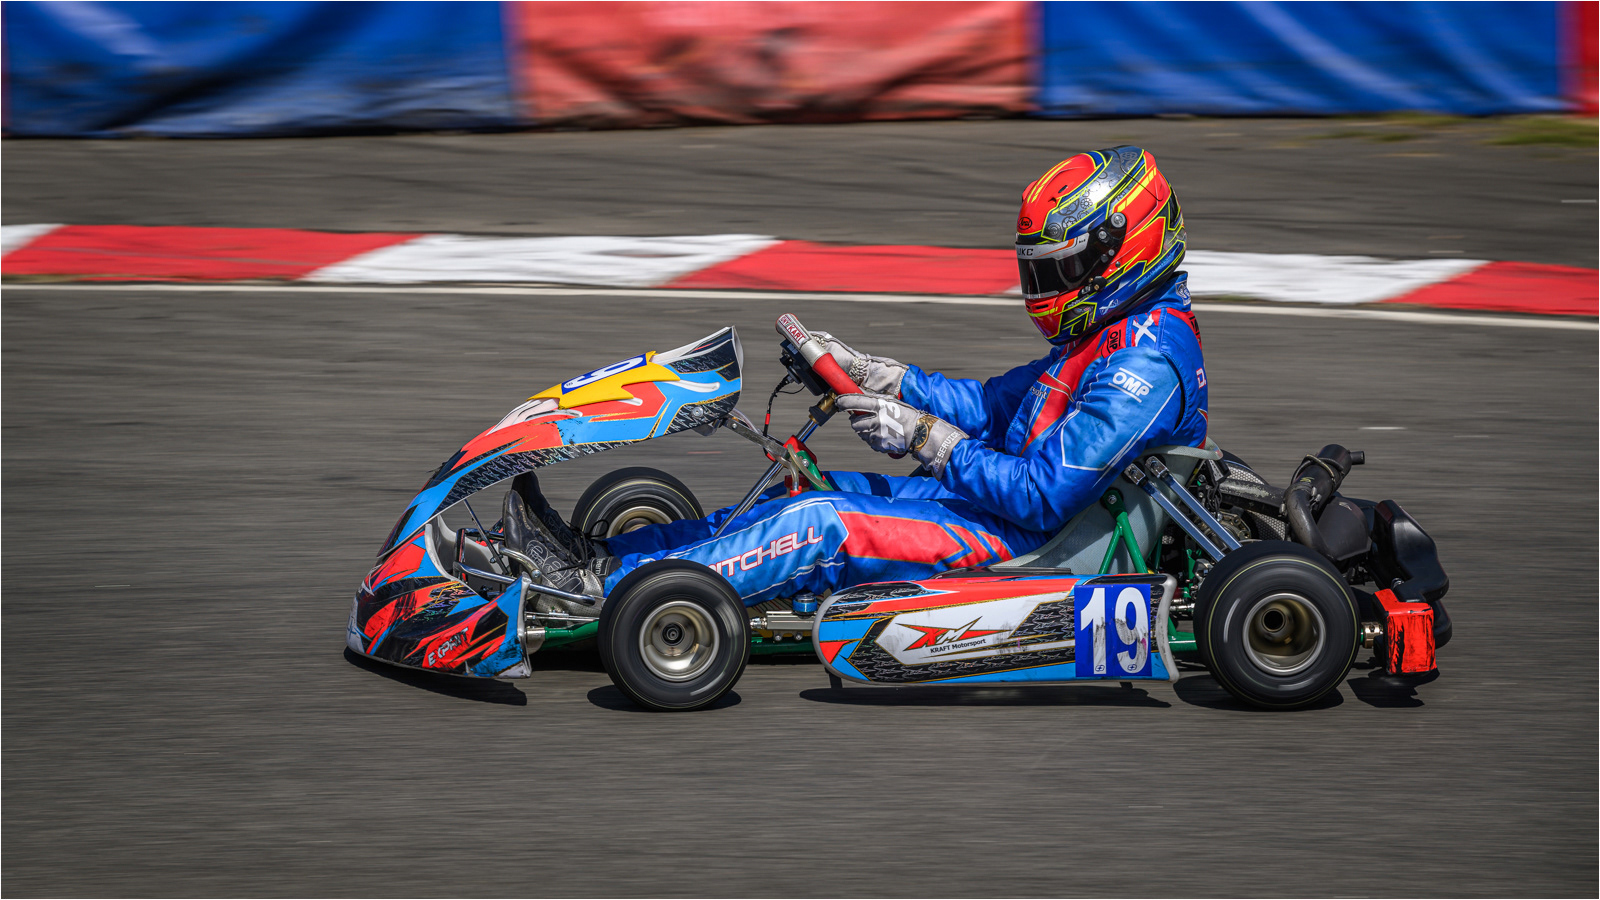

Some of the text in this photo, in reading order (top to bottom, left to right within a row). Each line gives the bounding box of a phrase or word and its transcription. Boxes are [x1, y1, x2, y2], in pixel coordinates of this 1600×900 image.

[1109, 331, 1119, 350] OMP
[1112, 371, 1150, 397] OMP
[937, 430, 961, 459] SERVICE
[707, 526, 824, 577] ITCHELL
[1081, 586, 1149, 675] 19
[930, 638, 986, 653] KRAFT Motorsport
